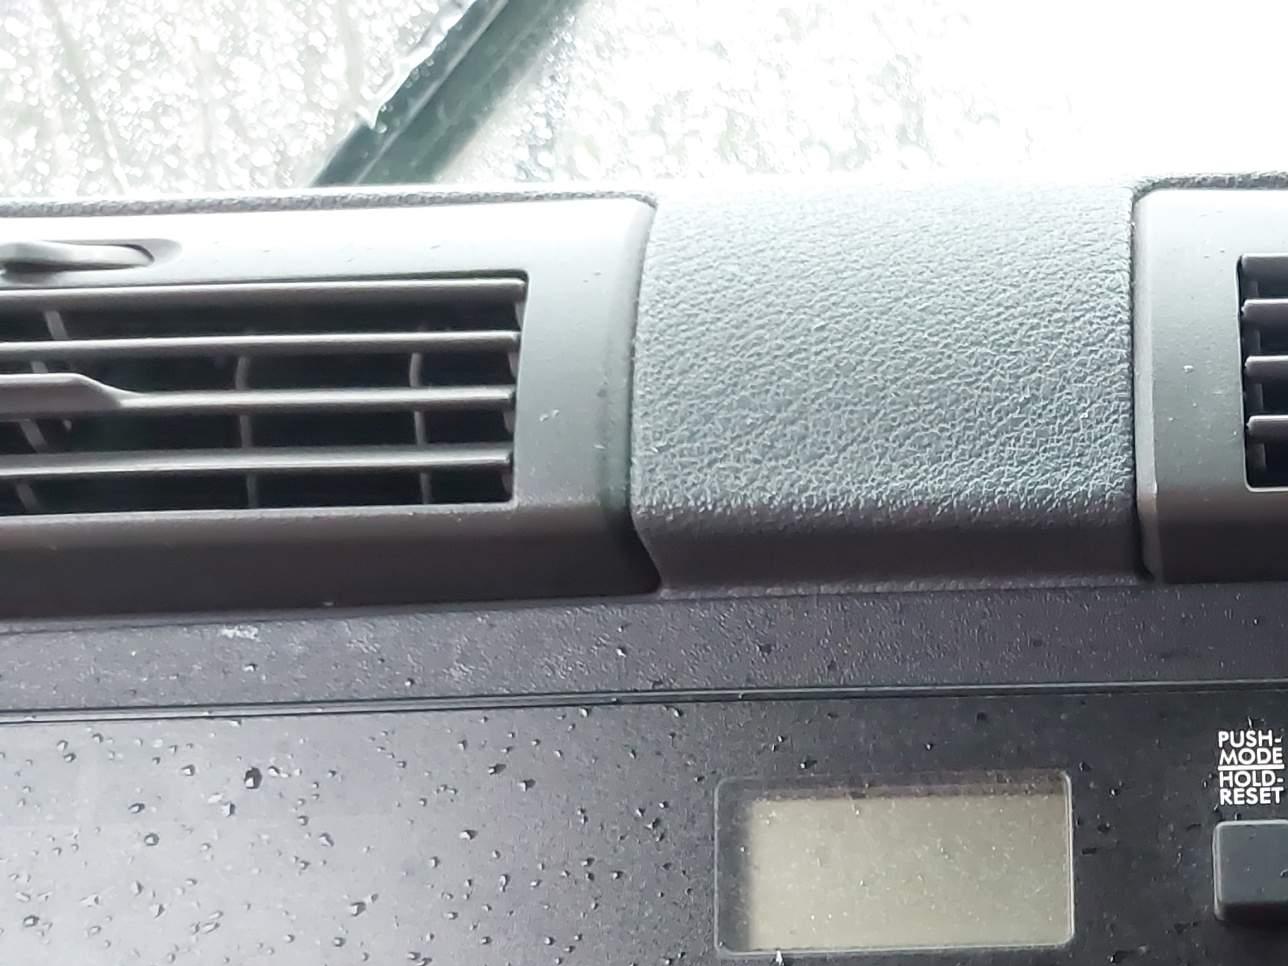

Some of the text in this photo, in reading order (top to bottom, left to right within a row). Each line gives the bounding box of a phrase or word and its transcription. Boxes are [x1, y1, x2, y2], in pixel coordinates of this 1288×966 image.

[1218, 729, 1282, 748] PUSH-
[1219, 747, 1283, 765] MODE
[1219, 770, 1284, 788] HOLD-
[1219, 787, 1284, 805] RESET
